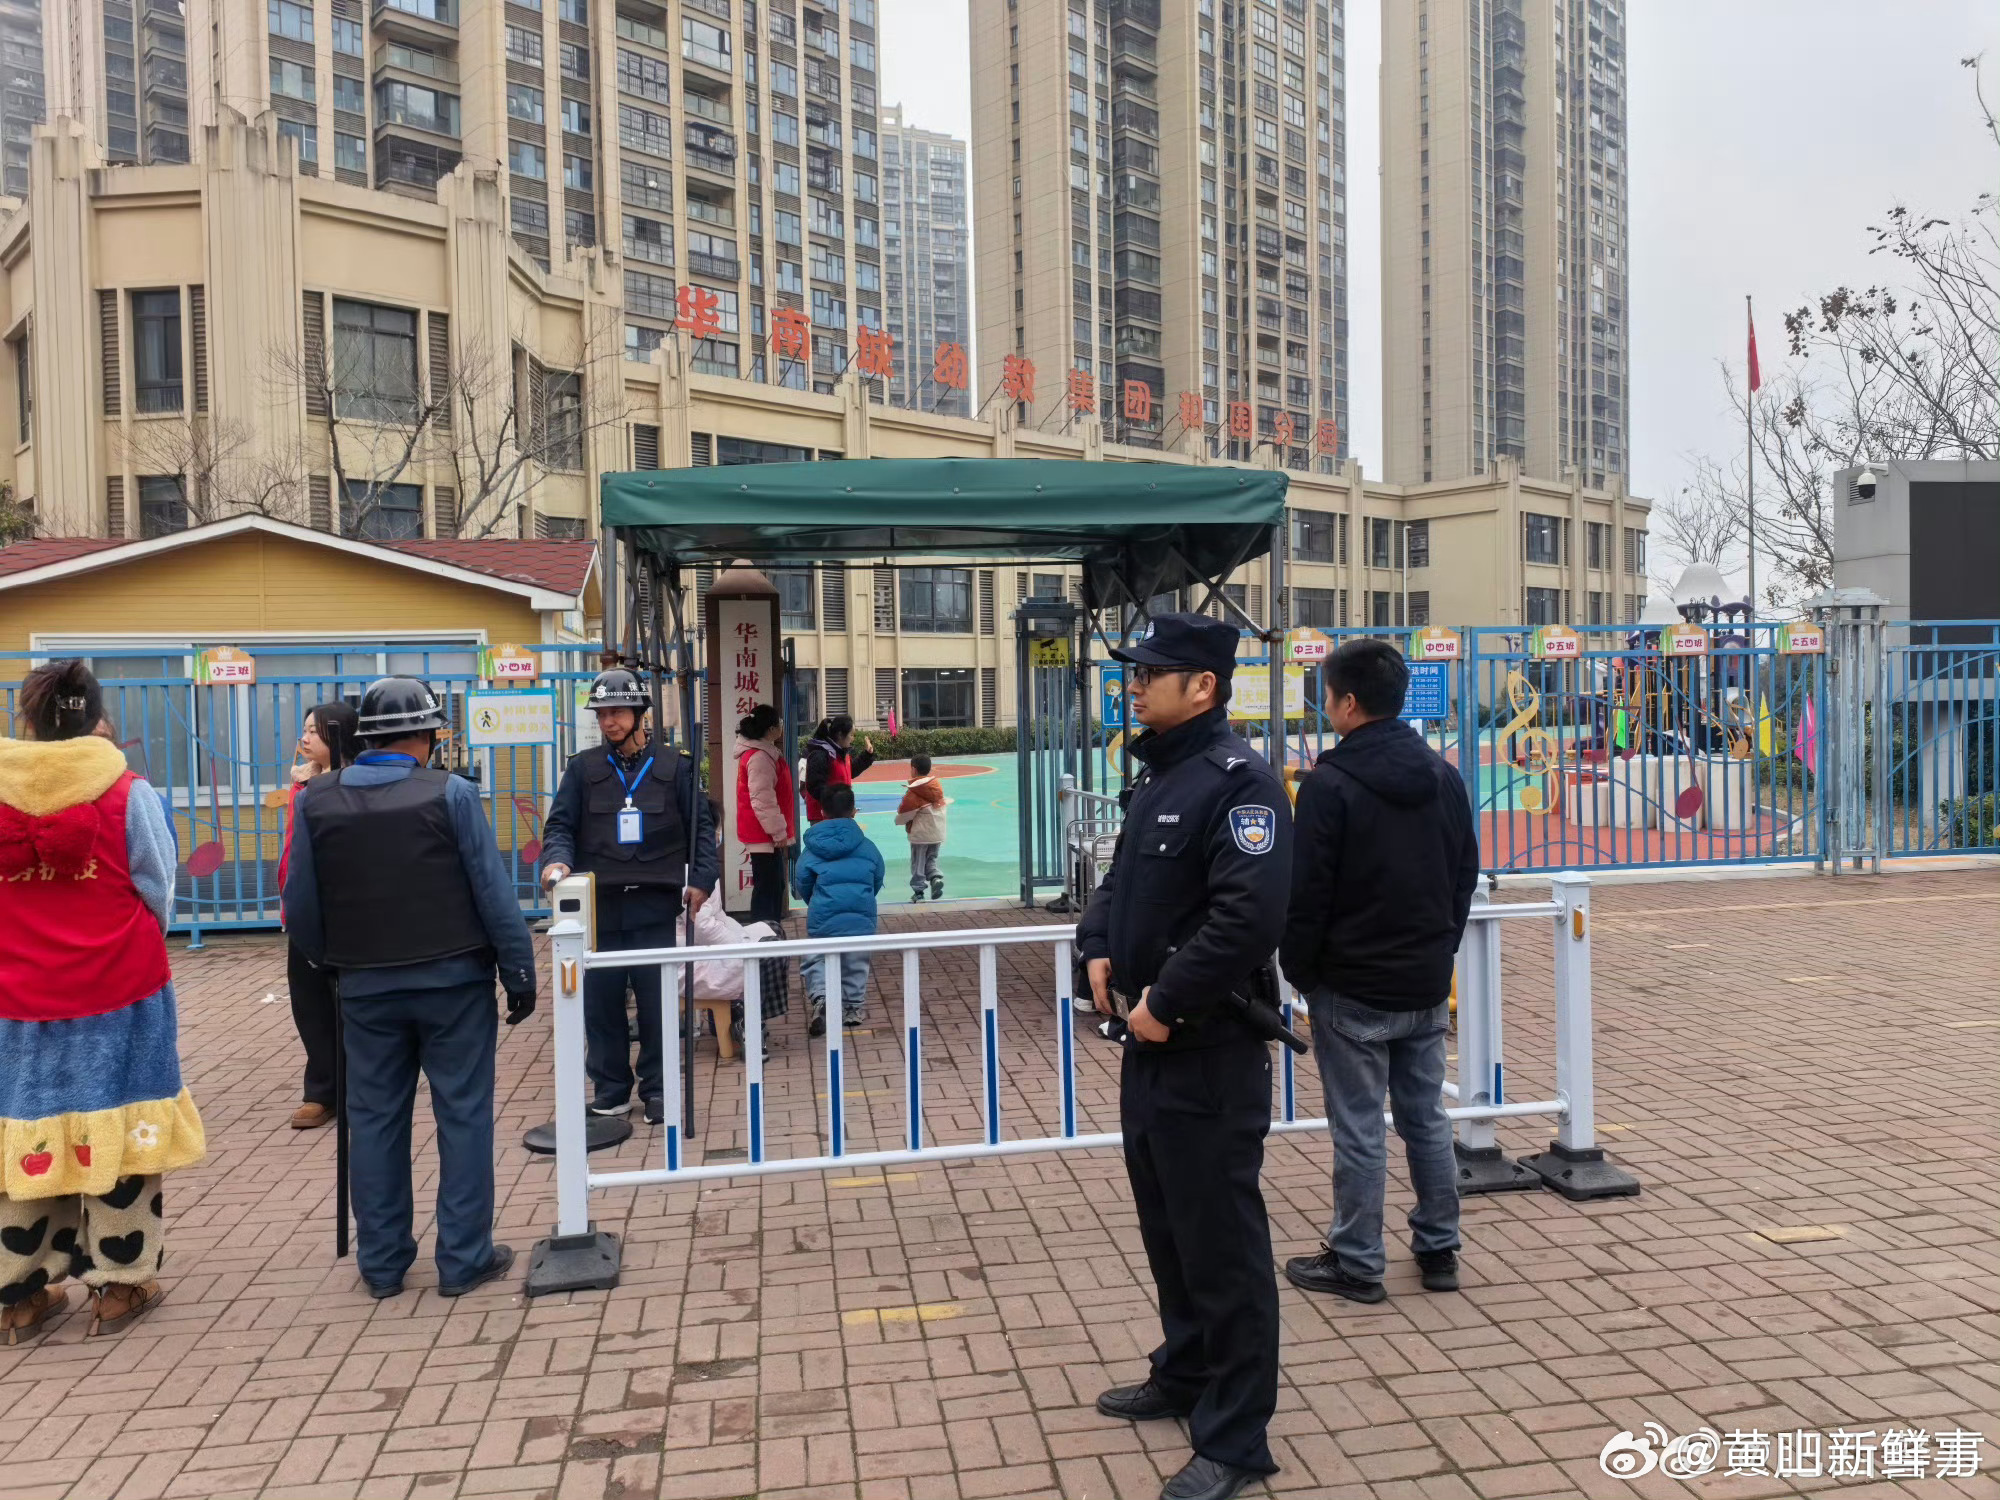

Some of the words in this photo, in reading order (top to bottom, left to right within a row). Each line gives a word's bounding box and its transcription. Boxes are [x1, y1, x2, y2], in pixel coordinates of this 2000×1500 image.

[1425, 643, 1457, 655] 中四班
[1546, 639, 1576, 653] 中五班
[1674, 637, 1704, 650] 大四班
[1790, 636, 1820, 650] 大五班
[1294, 645, 1325, 655] 中三班
[212, 665, 250, 676] 小三班
[496, 662, 534, 673] 小四班
